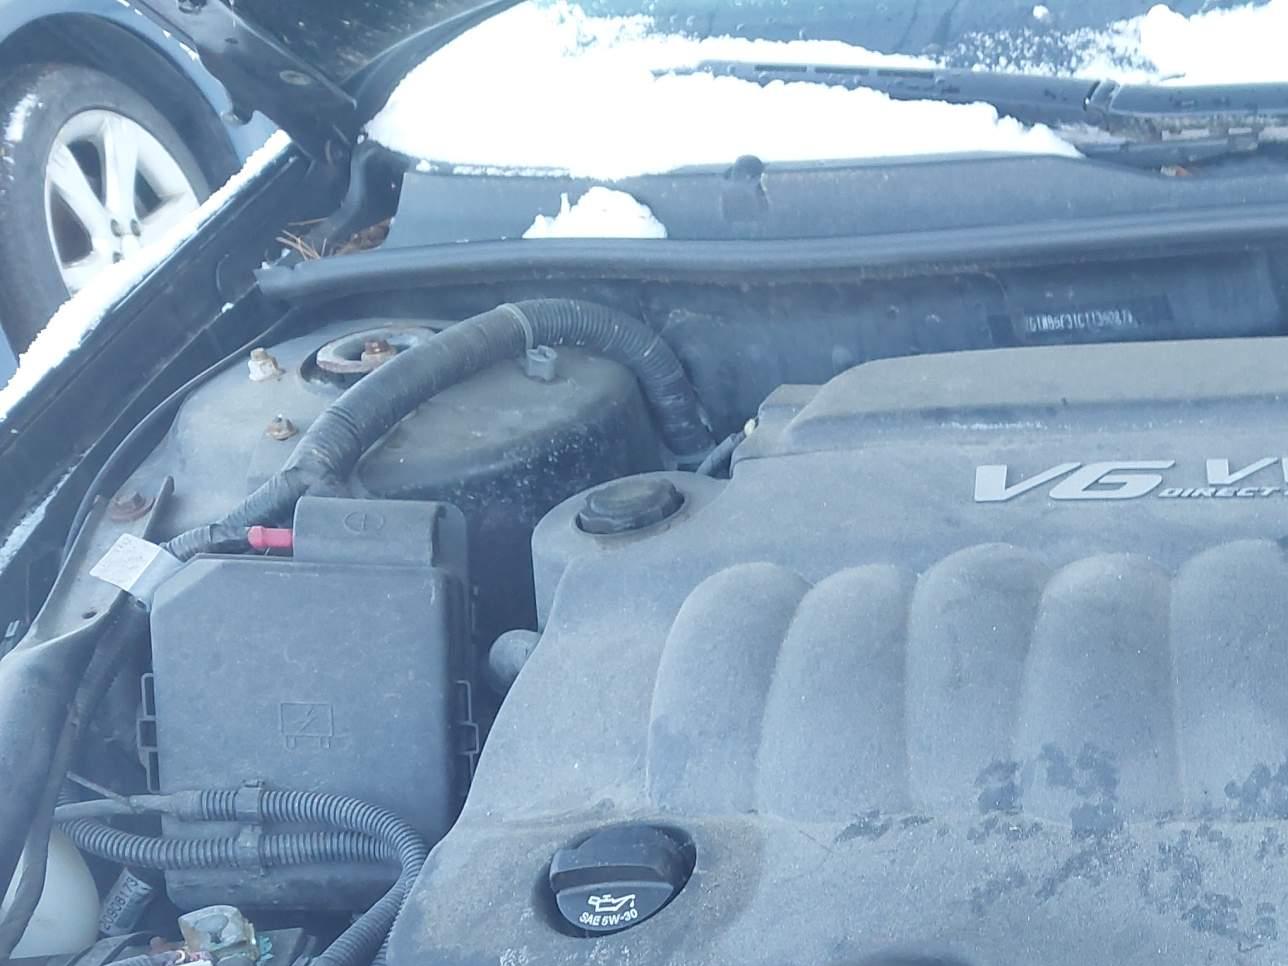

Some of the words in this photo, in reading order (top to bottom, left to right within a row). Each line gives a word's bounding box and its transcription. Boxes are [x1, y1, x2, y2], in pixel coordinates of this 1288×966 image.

[974, 460, 1176, 502] V6
[1157, 486, 1284, 498] DIRECT
[579, 912, 601, 926] SAE
[601, 908, 638, 926] 5W-30
